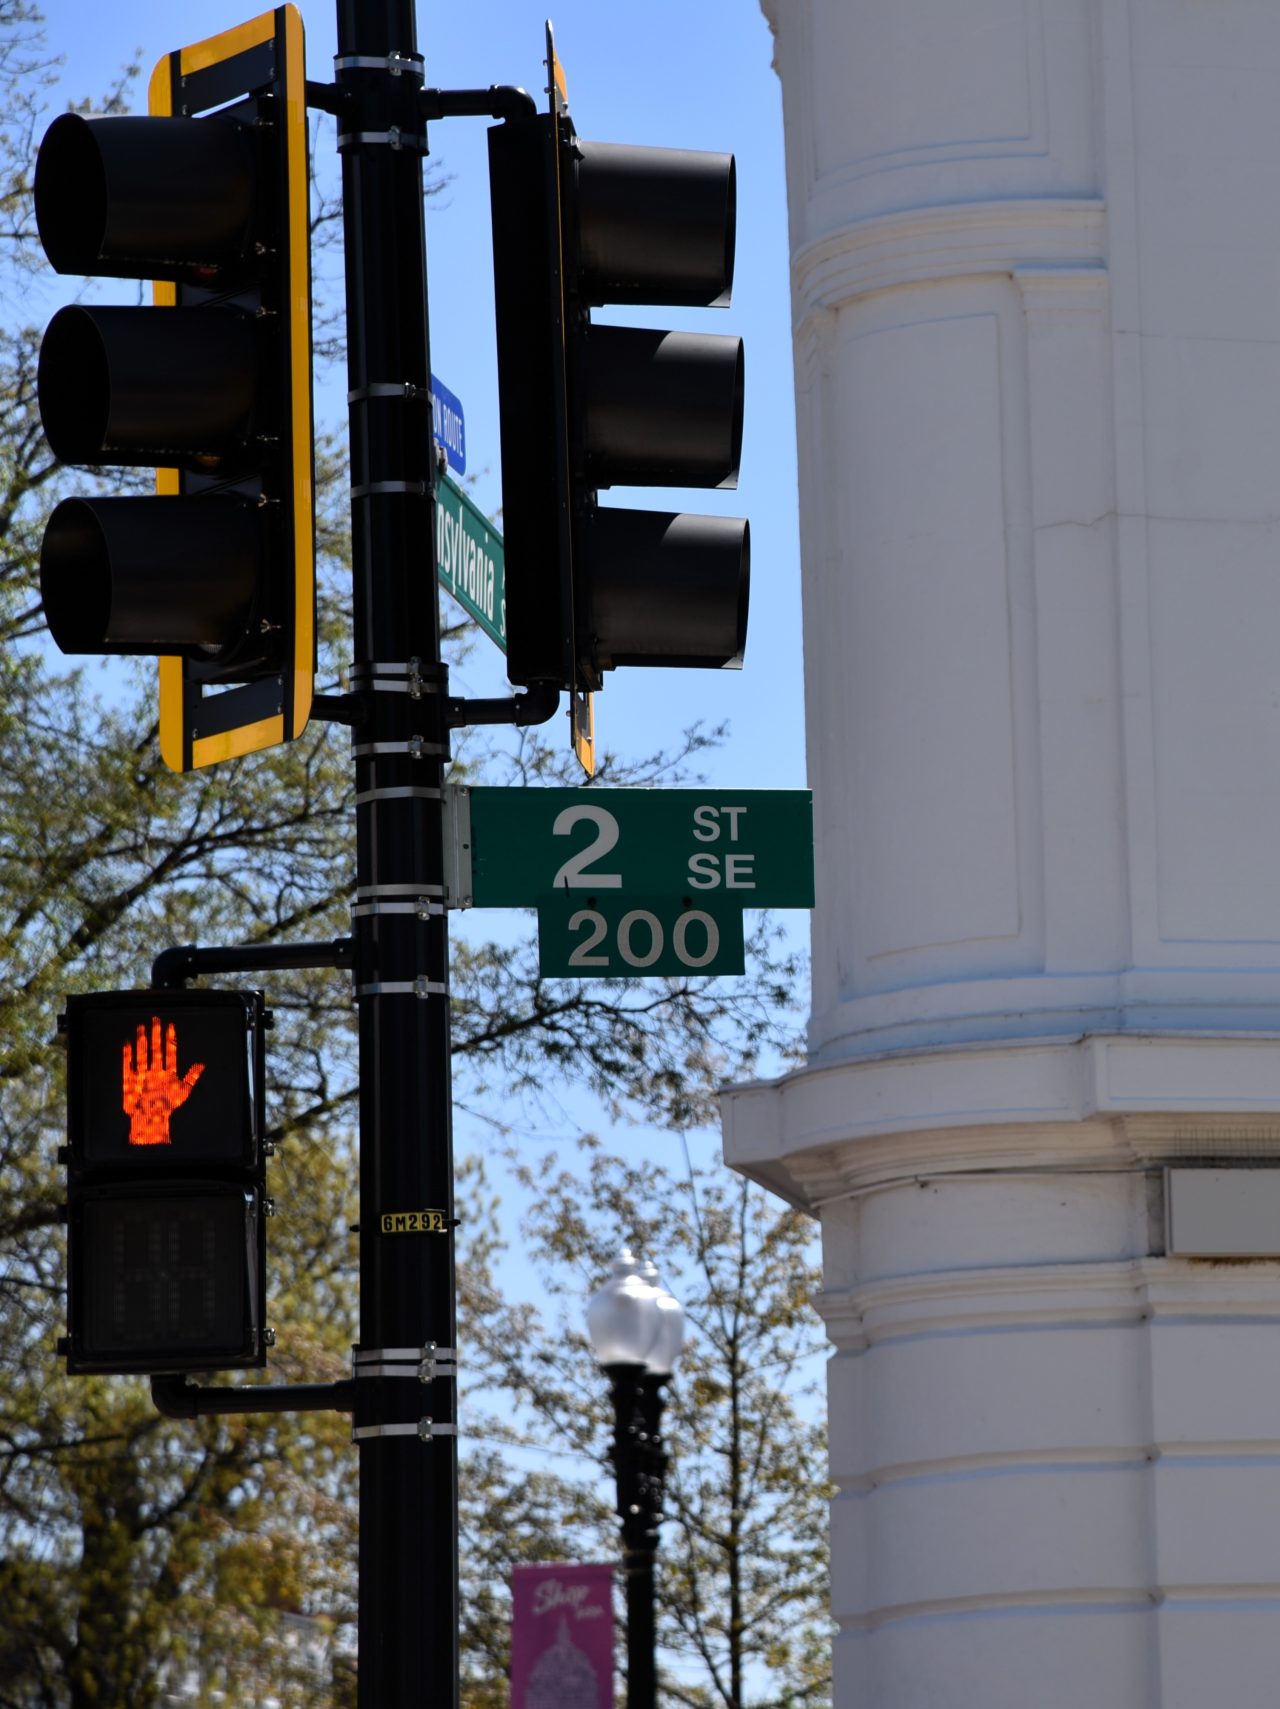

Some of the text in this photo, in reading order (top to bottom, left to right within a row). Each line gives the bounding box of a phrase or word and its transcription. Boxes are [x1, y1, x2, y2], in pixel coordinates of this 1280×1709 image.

[443, 403, 463, 458] ROUTE
[552, 804, 622, 889] 2
[693, 805, 748, 842] ST
[687, 853, 756, 890] SE
[567, 909, 720, 968] 200
